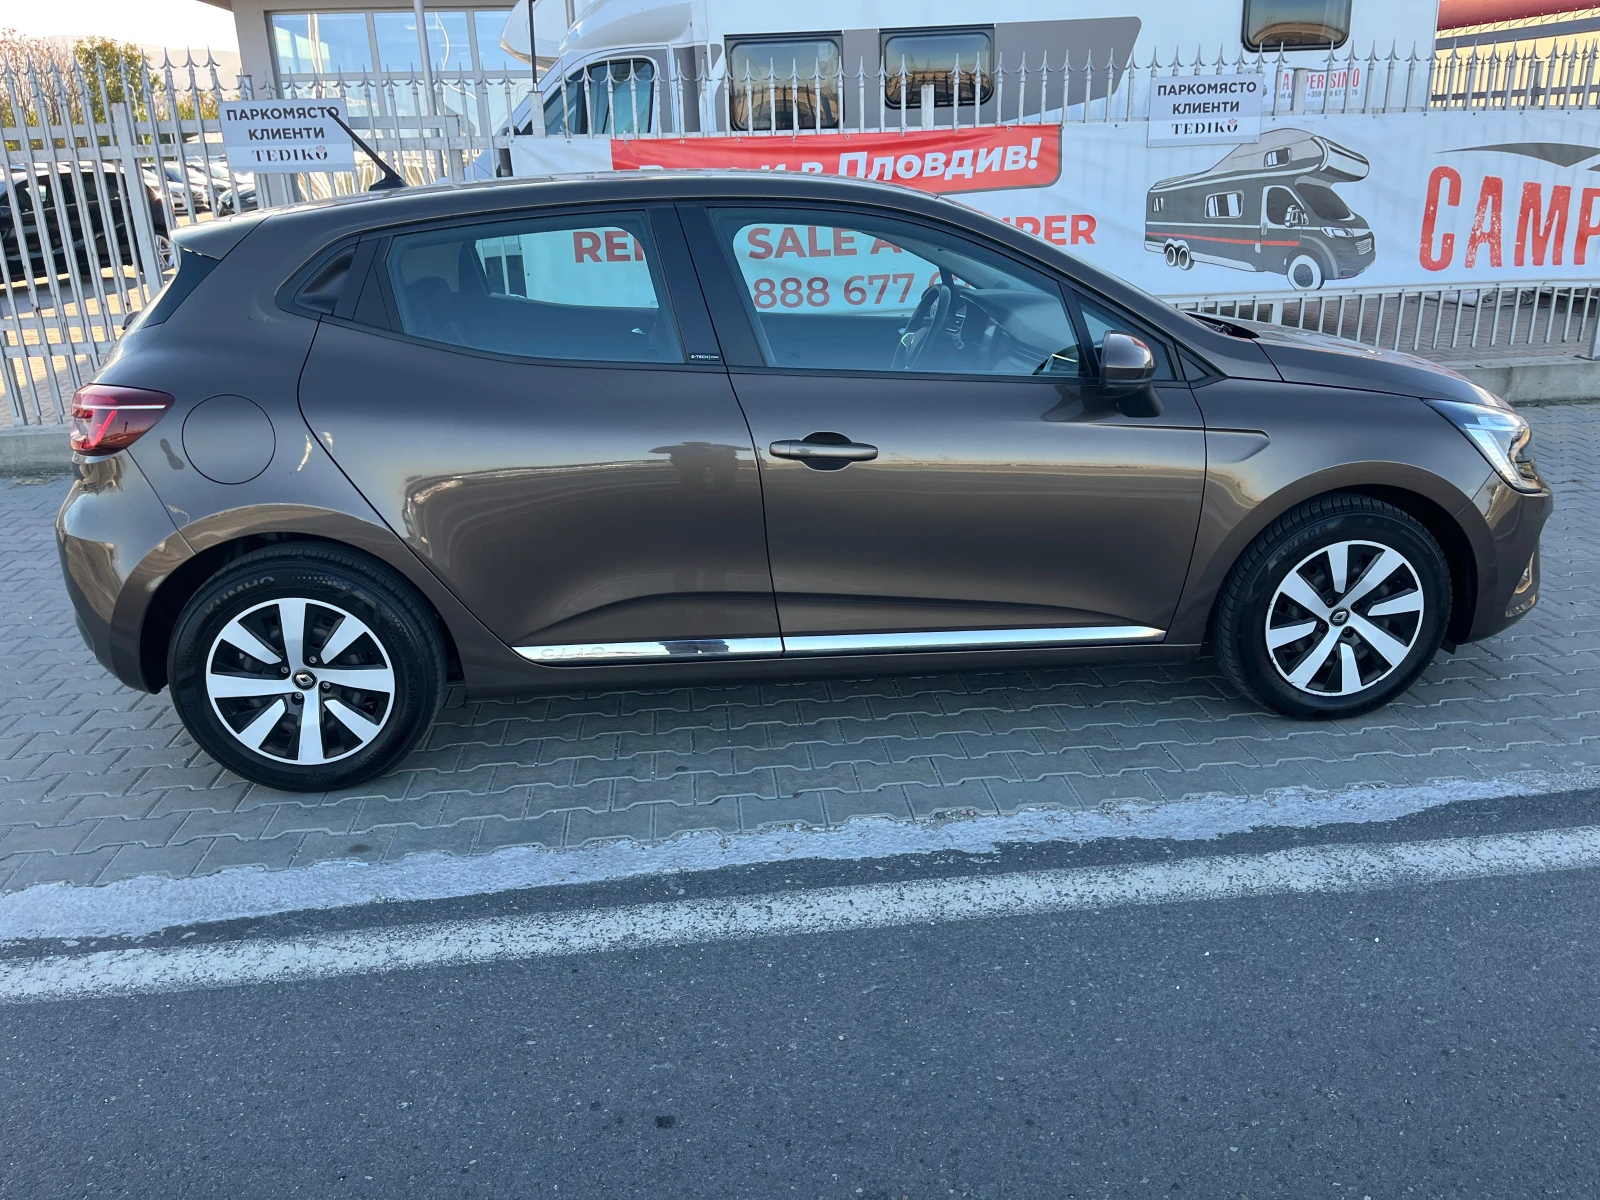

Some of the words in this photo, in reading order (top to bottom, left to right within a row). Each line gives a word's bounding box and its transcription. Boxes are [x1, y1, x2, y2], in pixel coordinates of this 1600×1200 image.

[1157, 81, 1257, 97] ПАРКОМЯСТО
[226, 106, 340, 121] ПАРКОМЯСТО
[1172, 101, 1240, 115] КЛИЕНТИ
[248, 127, 325, 141] КЛИЕНТИ
[1171, 119, 1238, 135] TEDIKO
[251, 147, 328, 162] TEDIKO
[838, 137, 1042, 181] Пловдив!
[747, 226, 857, 260] SALE
[843, 272, 915, 306] 677
